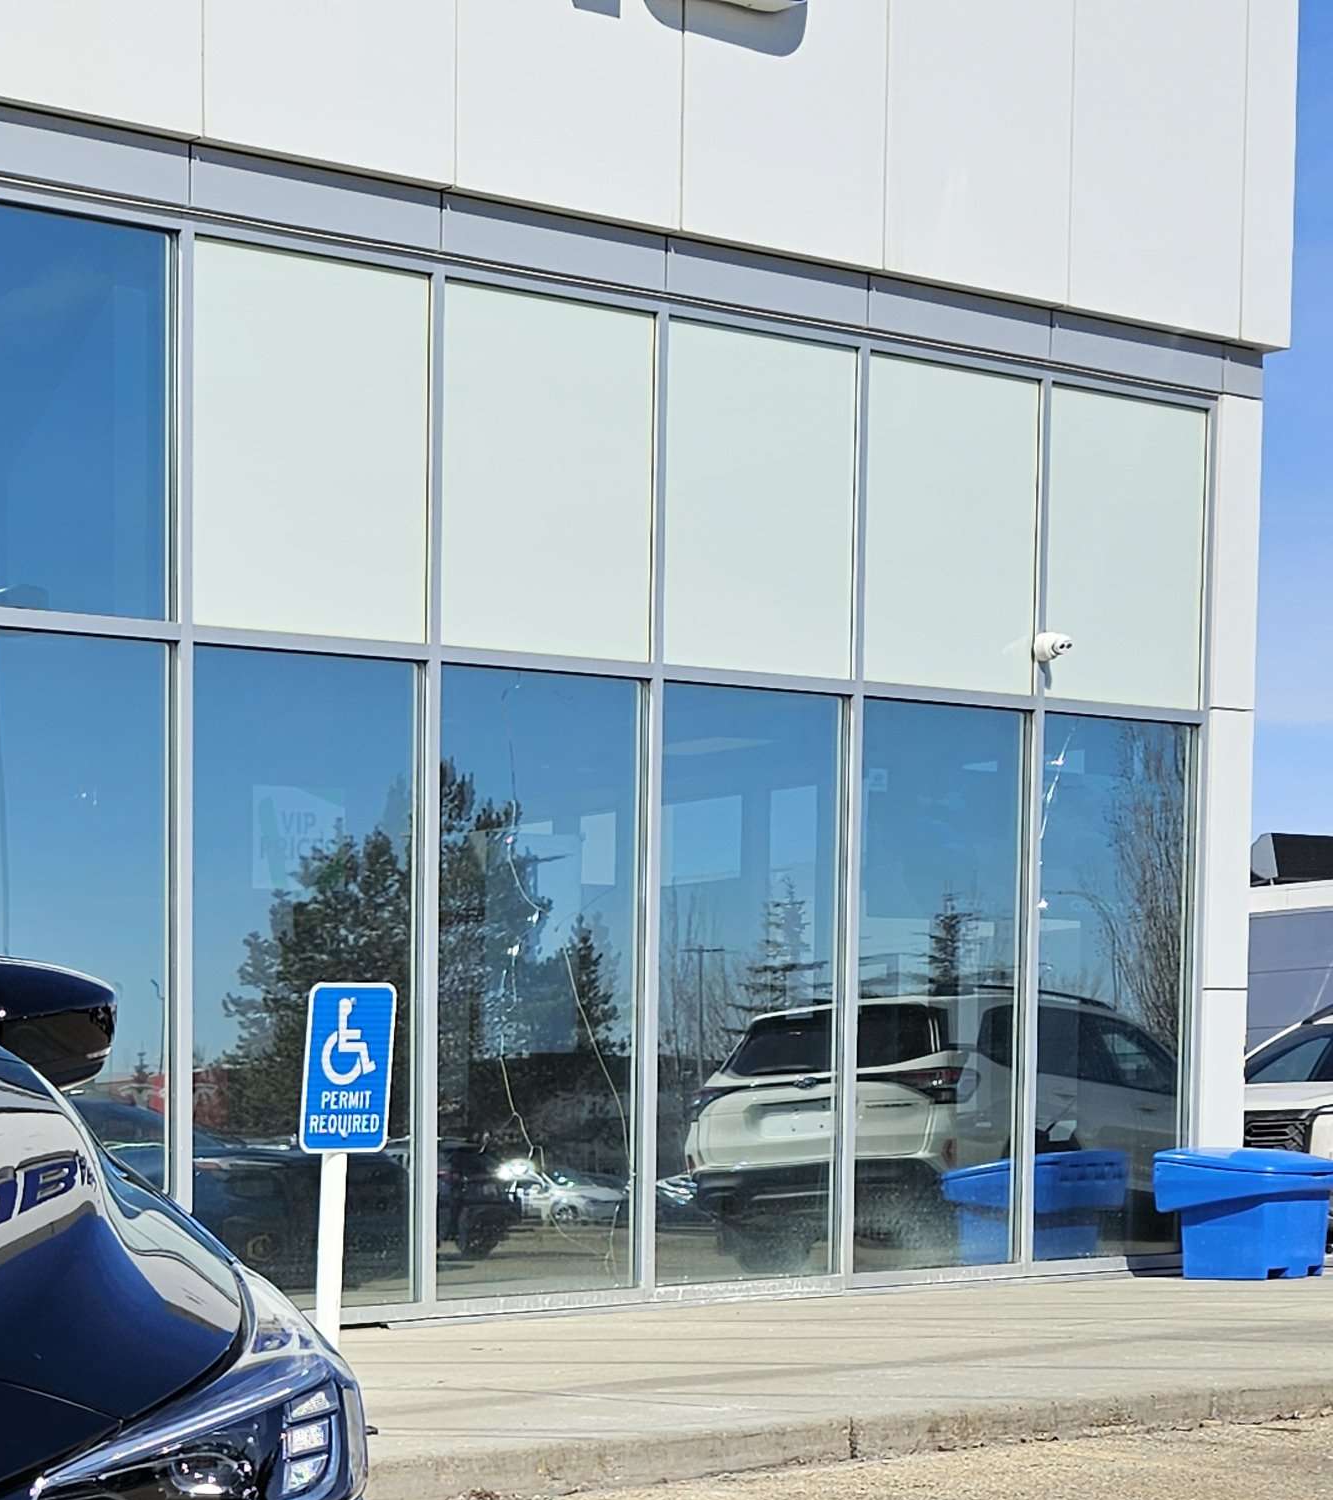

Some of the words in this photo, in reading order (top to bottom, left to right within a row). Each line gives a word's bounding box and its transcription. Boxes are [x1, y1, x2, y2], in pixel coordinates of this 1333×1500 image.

[280, 810, 318, 834] VIP
[321, 1090, 372, 1110] PERMIT
[309, 1113, 380, 1138] REQUIRED
